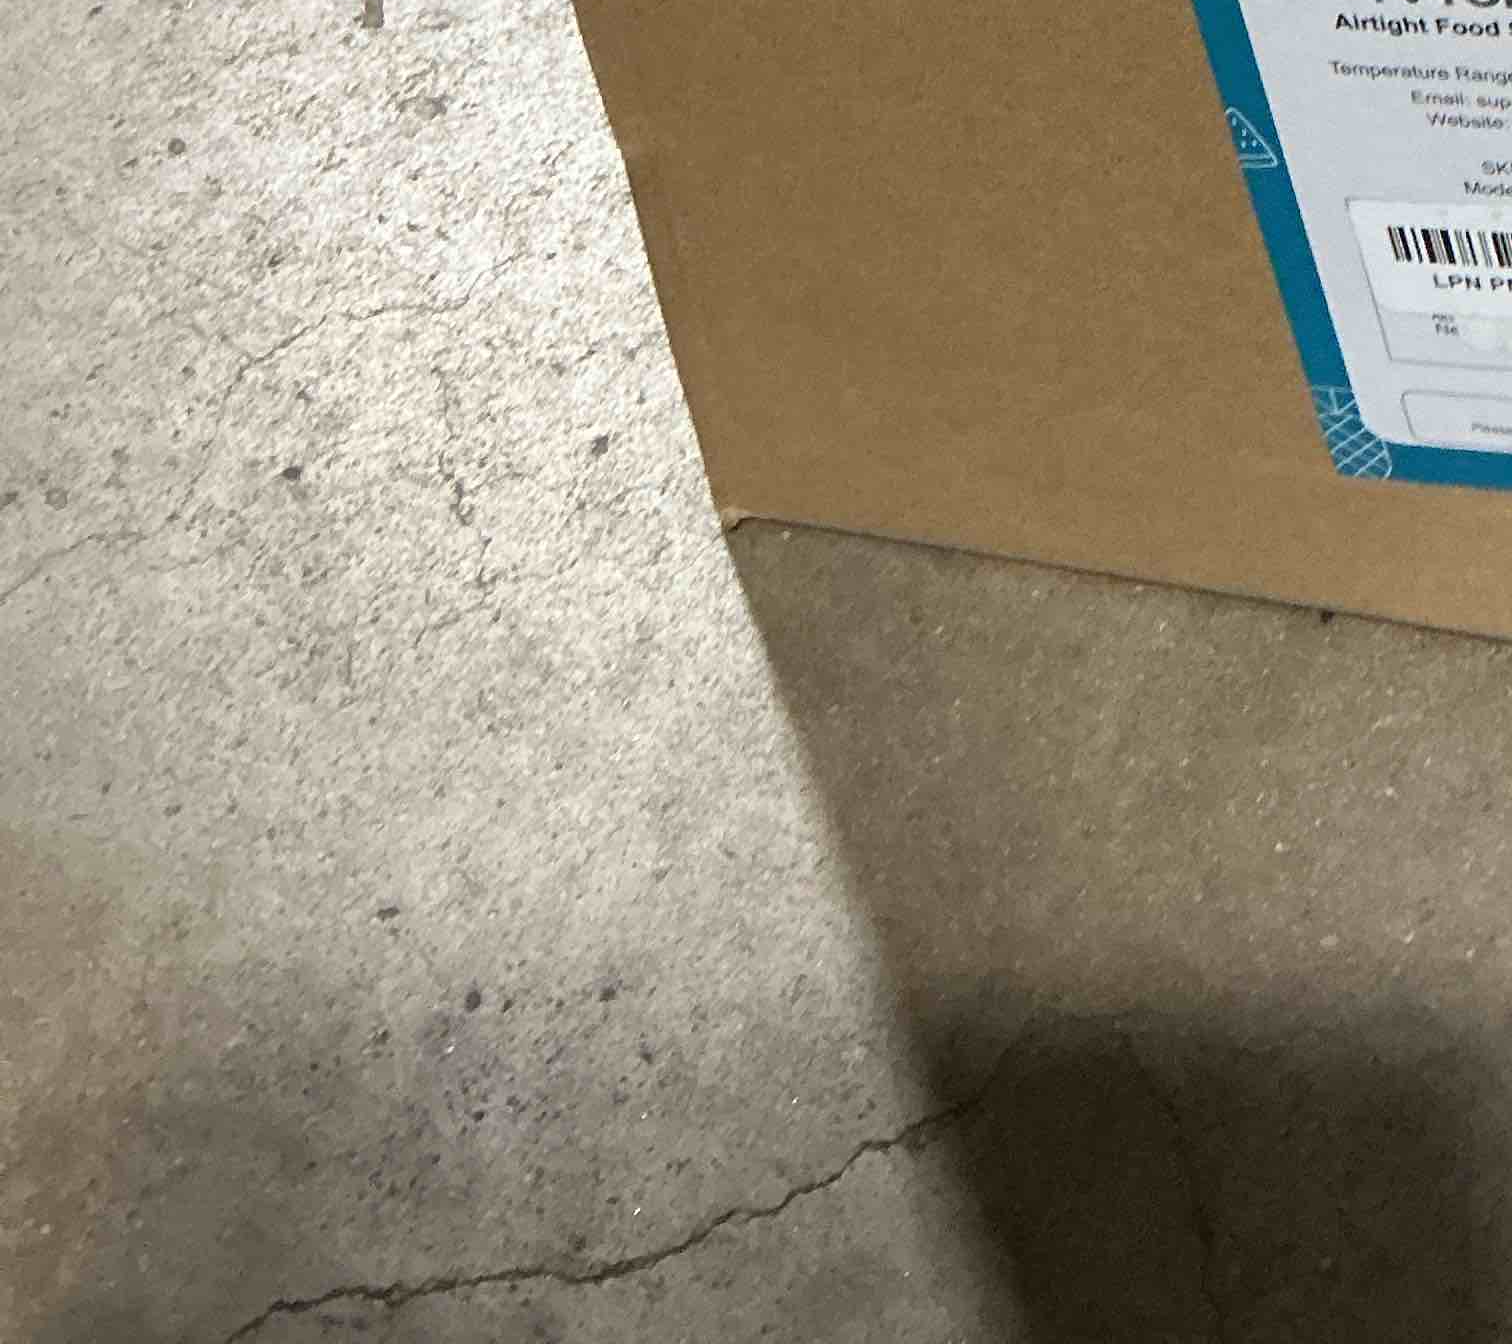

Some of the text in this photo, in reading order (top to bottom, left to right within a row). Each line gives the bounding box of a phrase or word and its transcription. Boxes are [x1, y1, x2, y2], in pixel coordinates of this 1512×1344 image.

[1335, 13, 1428, 37] Airtight
[1435, 17, 1501, 37] Food
[1330, 61, 1450, 82] Temperature
[1433, 273, 1482, 293] LPN
